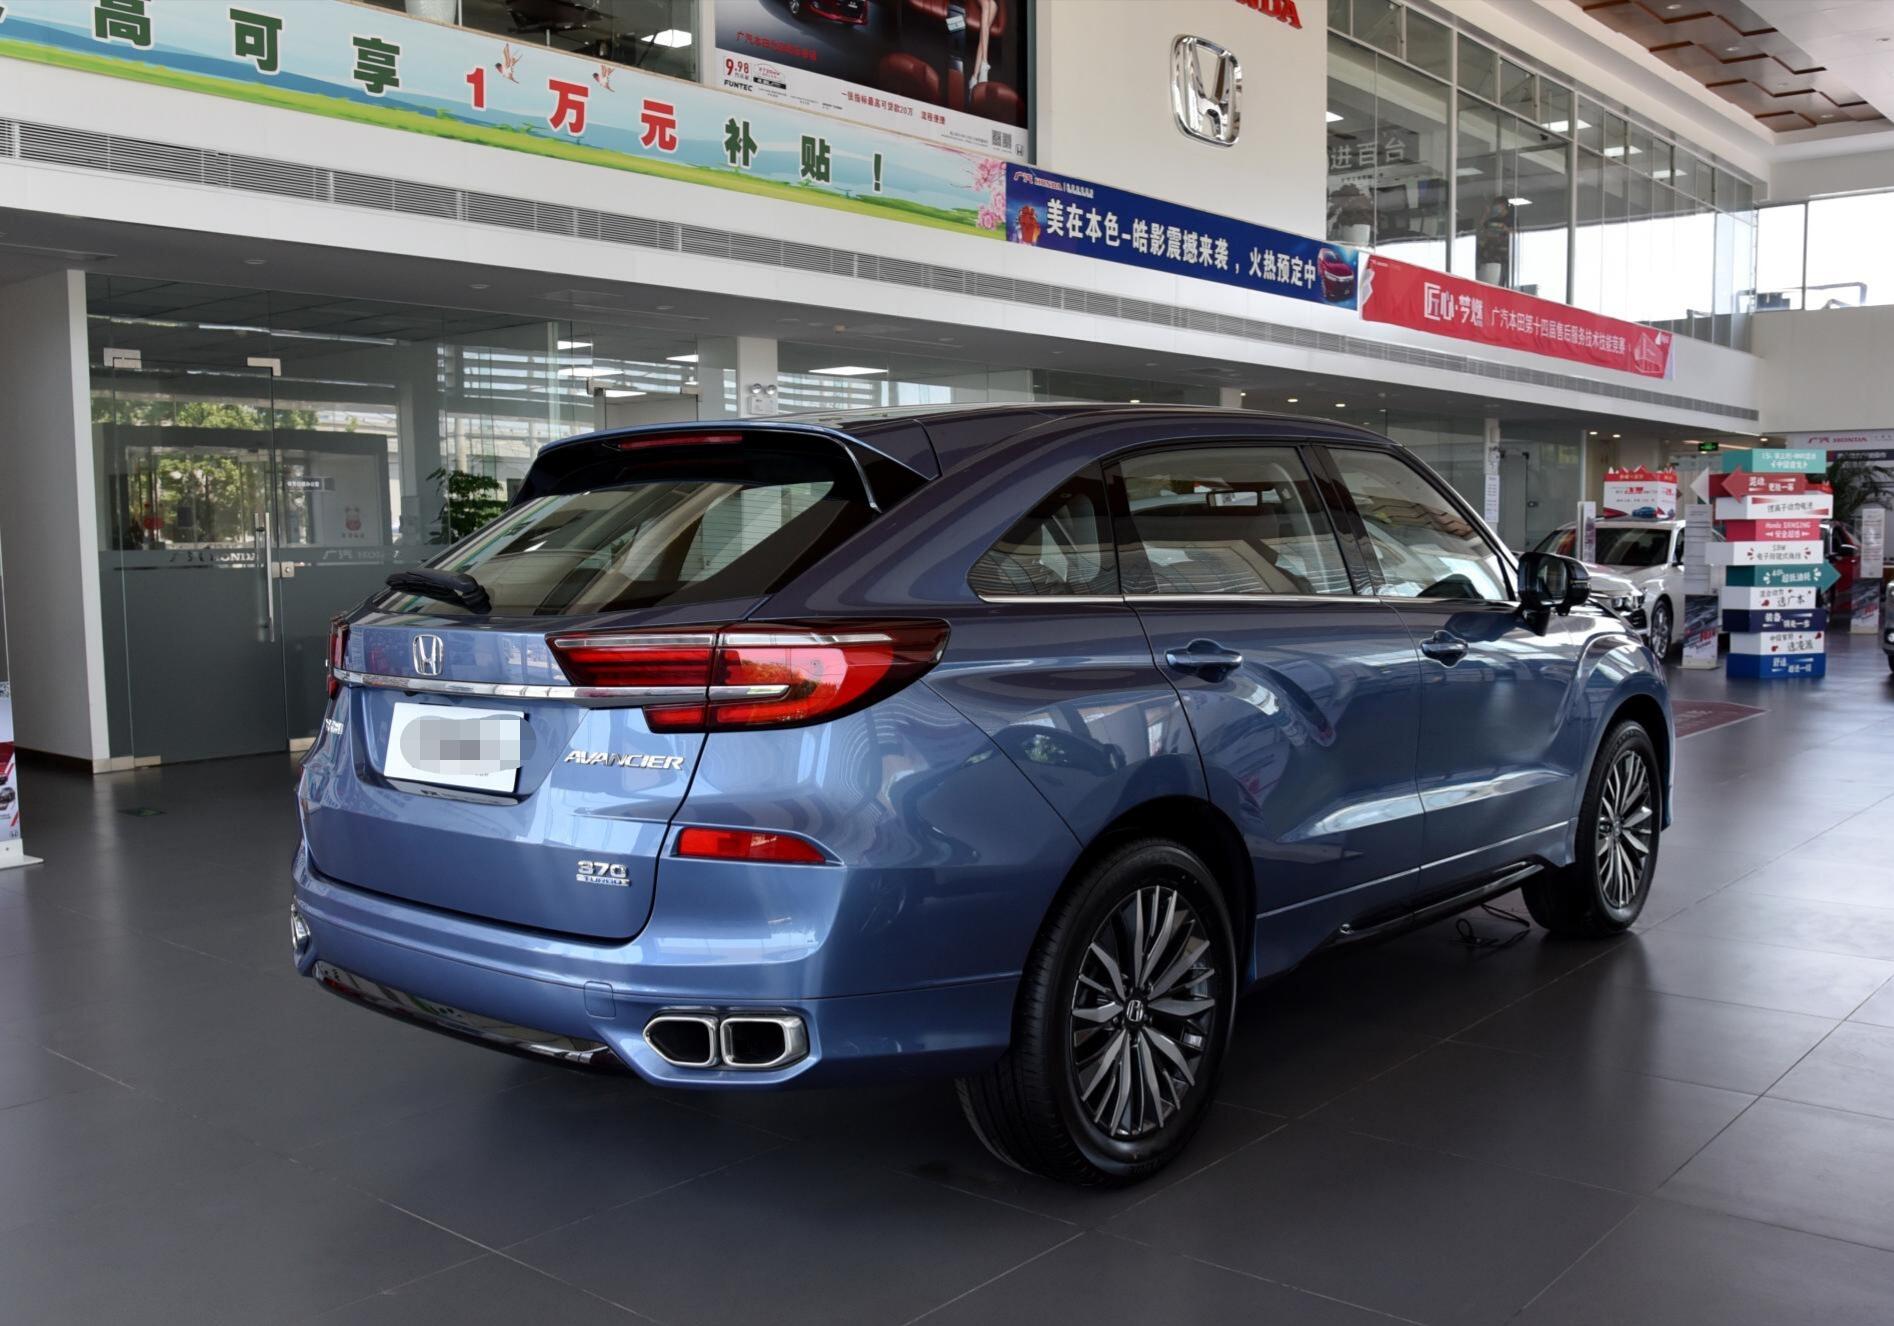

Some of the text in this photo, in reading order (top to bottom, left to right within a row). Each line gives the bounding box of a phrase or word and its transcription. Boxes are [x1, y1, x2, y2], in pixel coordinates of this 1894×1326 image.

[723, 79, 753, 92] FUNTEC
[564, 750, 685, 770] AVANCIER
[577, 860, 627, 878] 370
